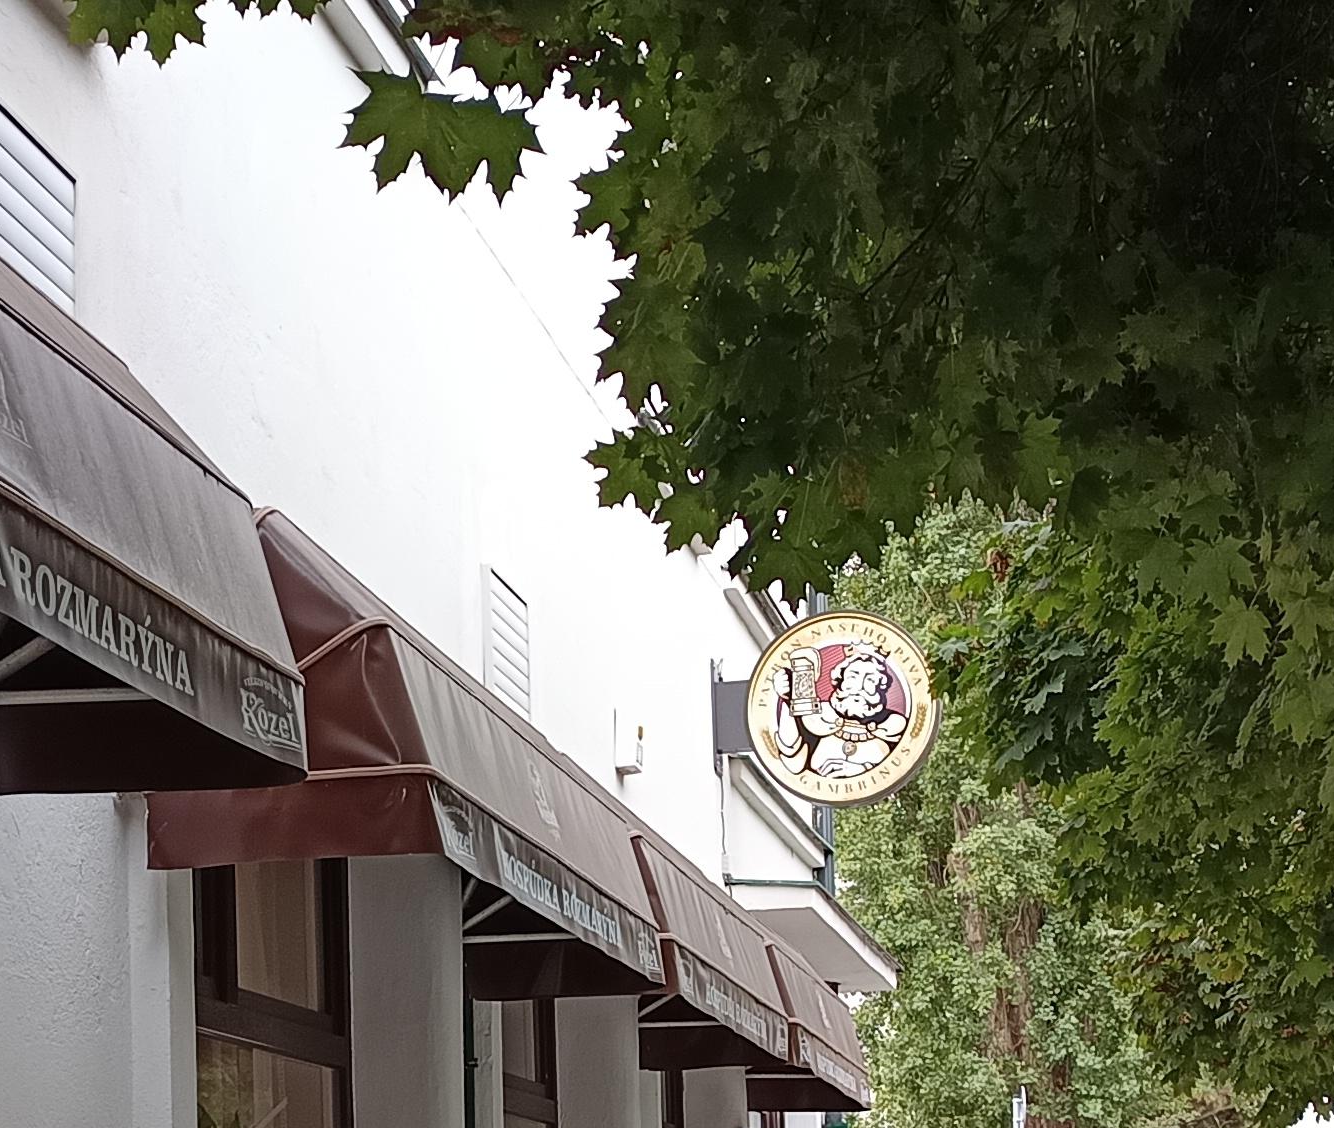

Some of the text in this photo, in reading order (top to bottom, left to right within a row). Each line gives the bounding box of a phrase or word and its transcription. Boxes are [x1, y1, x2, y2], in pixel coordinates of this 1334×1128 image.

[10, 545, 195, 696] ROZMARÝNA
[893, 646, 923, 687] PIVA
[240, 687, 301, 750] Kozel
[799, 745, 911, 795] GAMBRINUS
